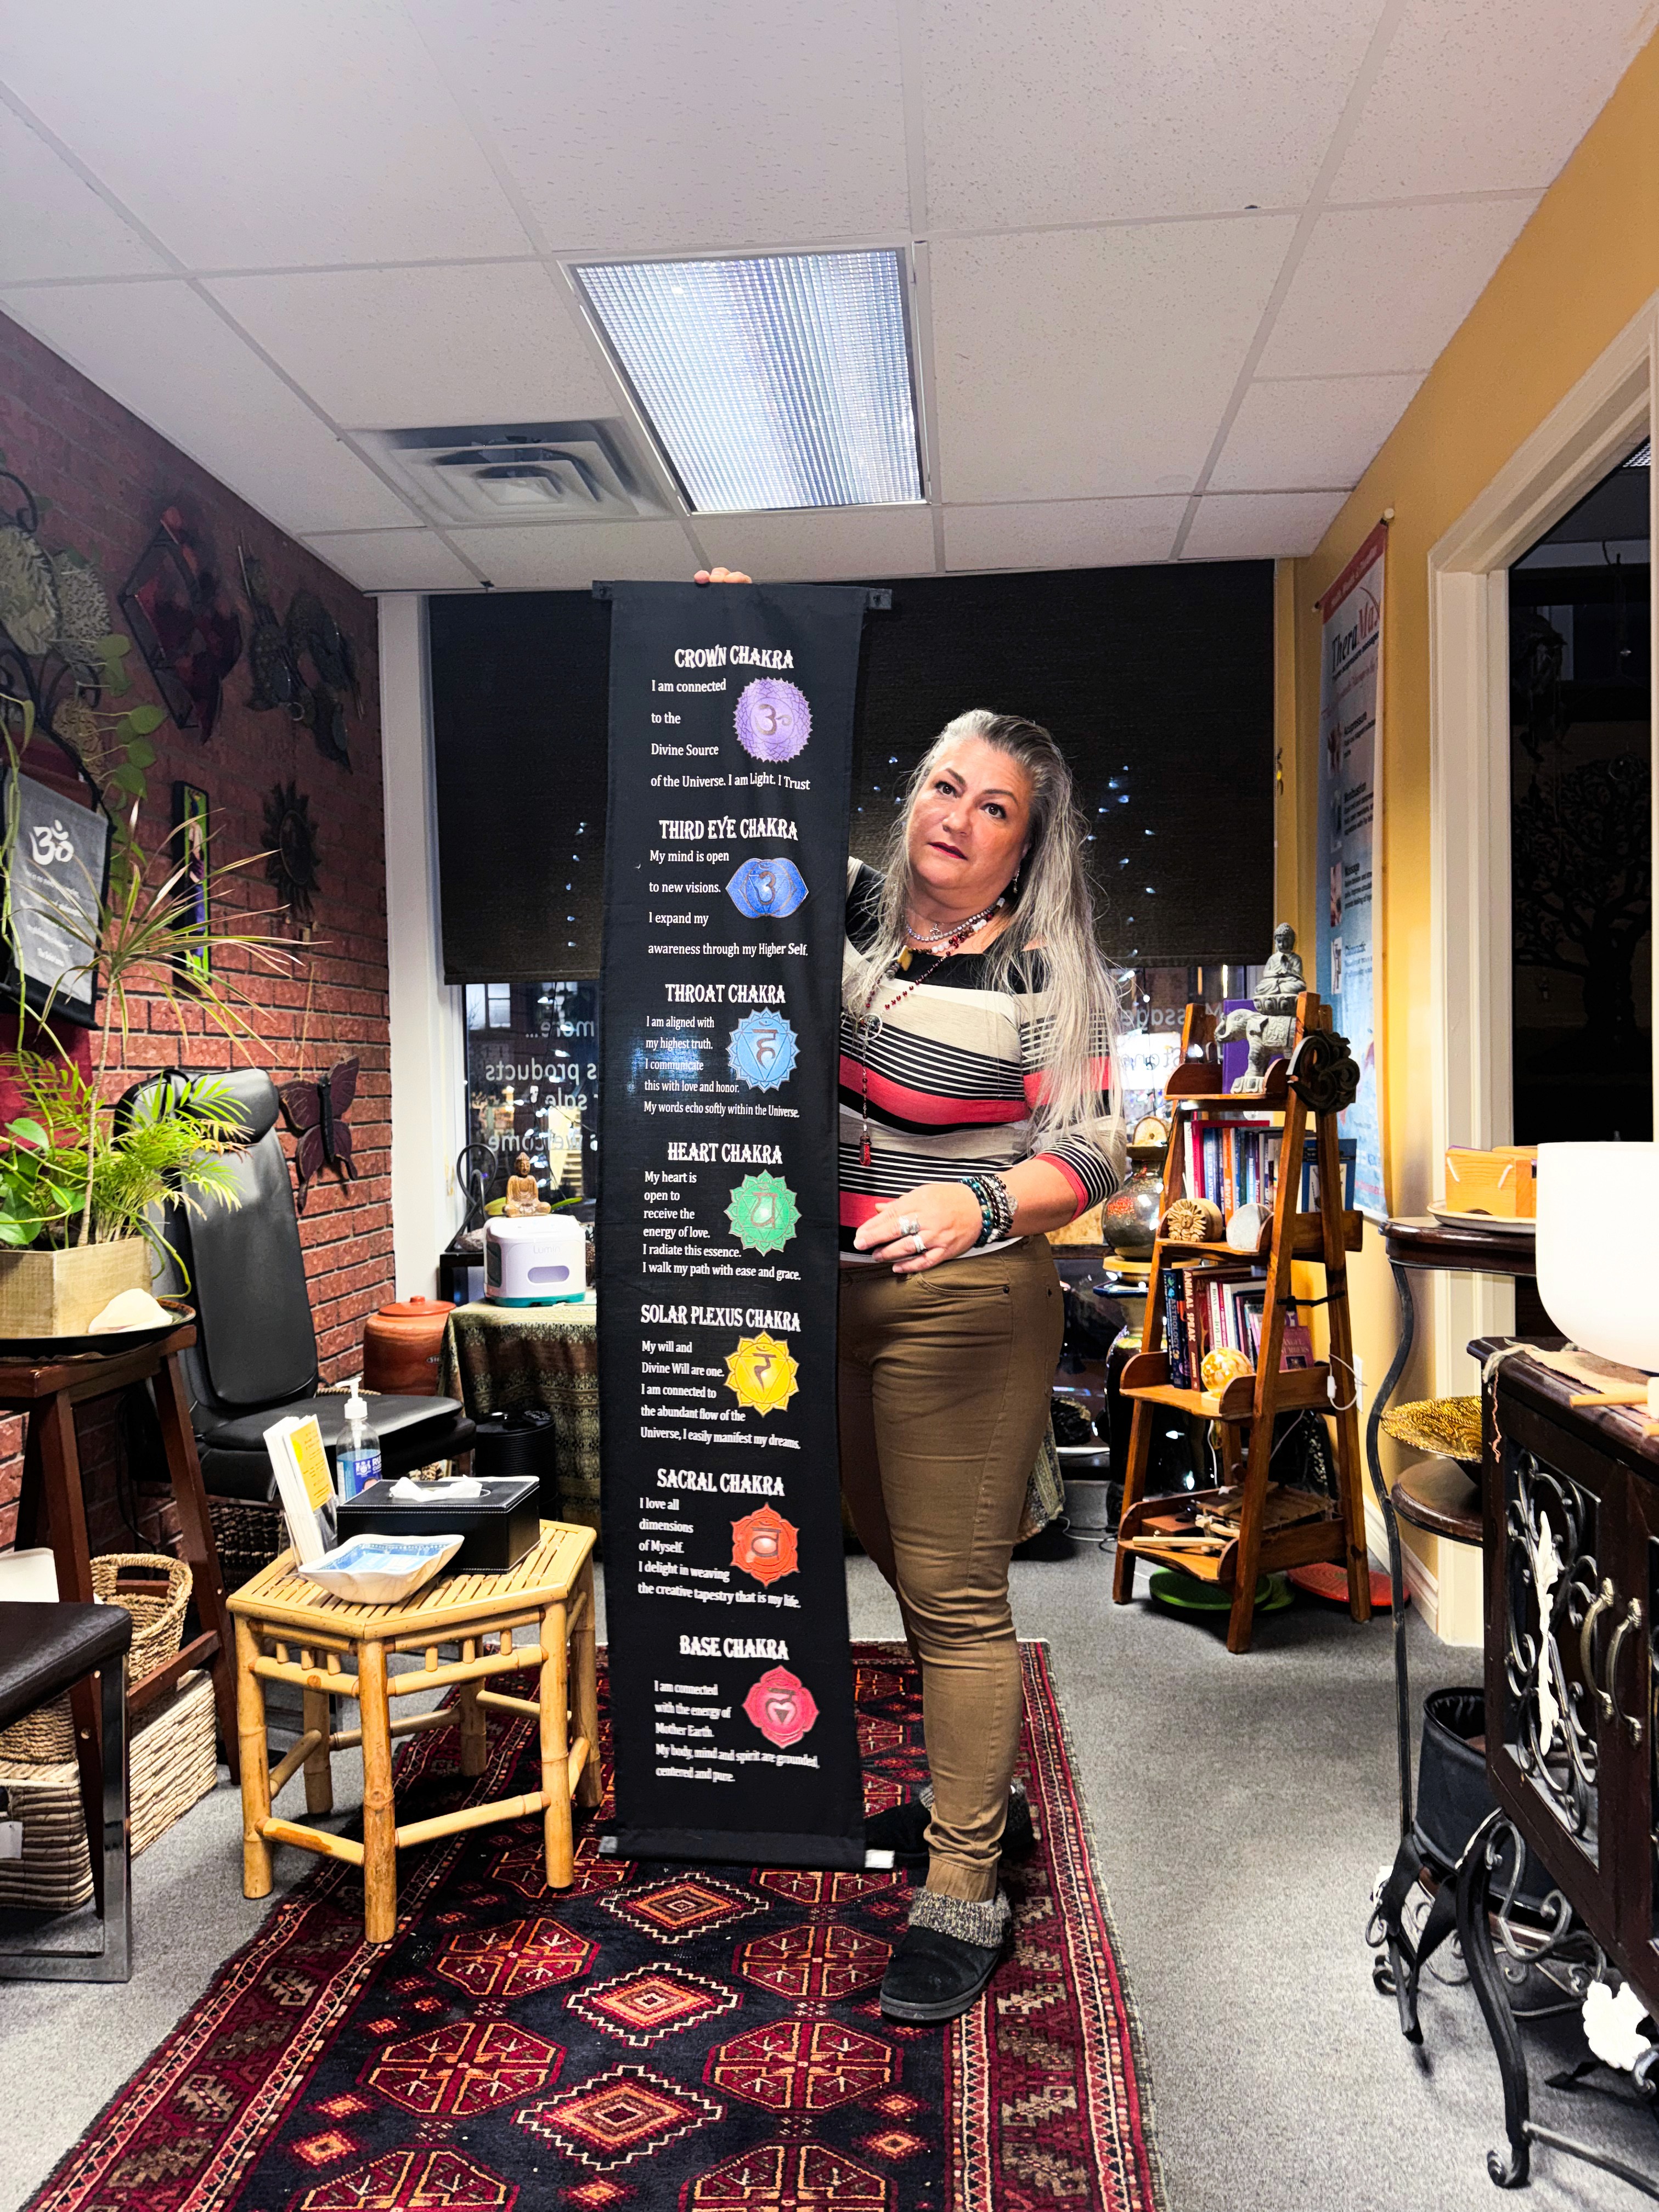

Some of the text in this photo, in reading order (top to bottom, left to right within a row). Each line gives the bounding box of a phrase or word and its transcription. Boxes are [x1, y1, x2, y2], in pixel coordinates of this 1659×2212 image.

[674, 644, 794, 670] CROWN CHAKRA
[651, 678, 726, 692] I am connected
[651, 711, 681, 724] to the
[651, 743, 719, 756] Divine Source
[650, 771, 811, 790] of the Universe. I am Light. I Trust
[658, 815, 799, 841] THIRD EYE CHAKRA
[650, 849, 730, 865] My mind is open
[648, 882, 721, 893] to new visions.
[648, 911, 709, 927] I expand my
[648, 942, 808, 958] awareness through my Higher Self.
[664, 984, 786, 1005] THROAT CHAKRA
[646, 1015, 715, 1031] I am aligned with
[645, 1036, 713, 1053] my highest truth.
[644, 1058, 704, 1072] I communicate
[644, 1079, 740, 1093] this with love and honor.
[644, 1101, 800, 1118] My words echo softly within the Universe.
[667, 1142, 783, 1165] HEART CHAKRA
[645, 1170, 697, 1186] My heart is
[644, 1190, 680, 1204] open to
[643, 1207, 695, 1220] receive the
[643, 1226, 710, 1240] energy of love.
[533, 1245, 561, 1254] Lumin
[642, 1243, 742, 1257] I radiate this essence.
[642, 1261, 802, 1282] I walk my path with ease and grace.
[1183, 1271, 1196, 1342] ANIMAL SPEAK
[640, 1304, 802, 1333] SOLAR PLEXUS CHAKRA
[1170, 1298, 1180, 1348] ASTROLOGY
[641, 1340, 693, 1355] My will and
[641, 1362, 725, 1377] Divine Will are one.
[641, 1383, 717, 1398] I am connected to
[640, 1404, 746, 1421] the abundant flow of the
[640, 1426, 801, 1449] Universe, I easily manifest my dreams.
[656, 1468, 785, 1497] SACRAL CHAKRA
[640, 1497, 680, 1510] I love all
[639, 1517, 694, 1533] dimensions
[639, 1539, 685, 1555] of Myself.
[639, 1560, 730, 1583] I delight in weaving
[637, 1582, 802, 1609] the creative tapestry that is my life.
[679, 1634, 790, 1661] BASE CHAKRA
